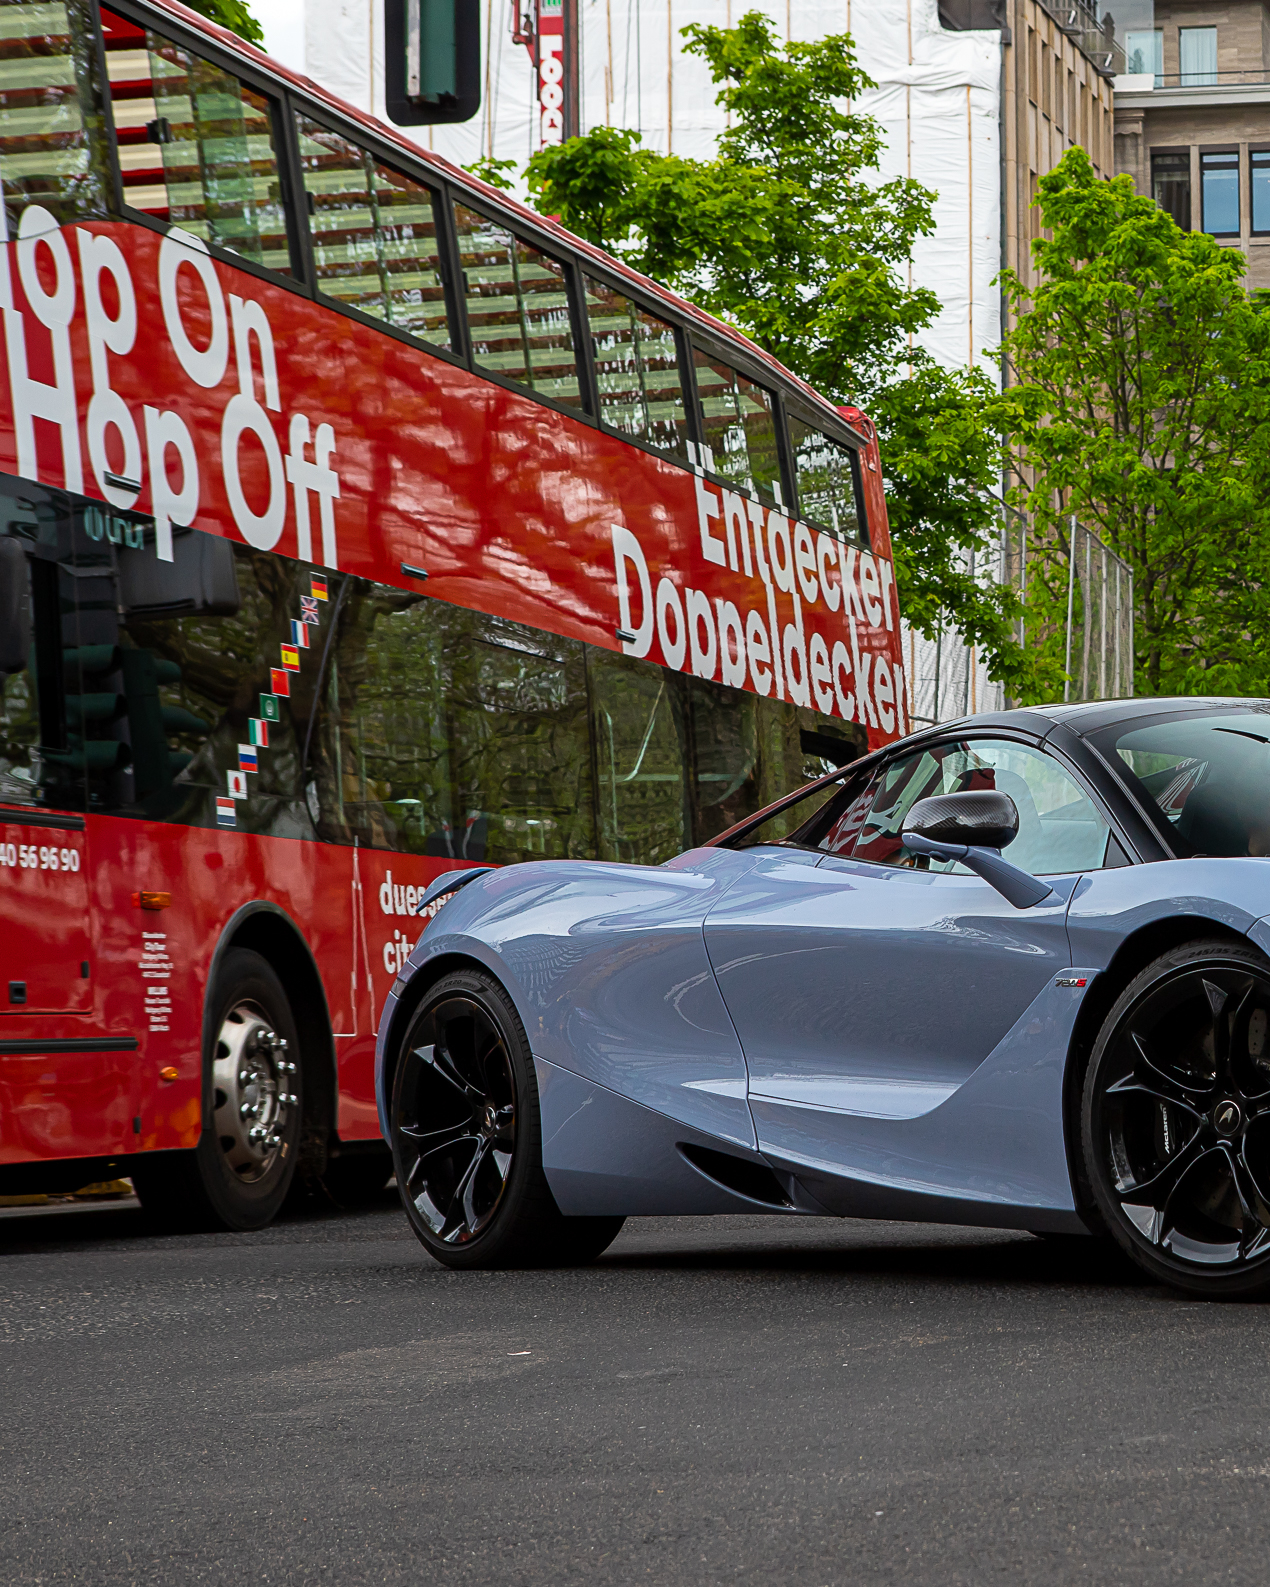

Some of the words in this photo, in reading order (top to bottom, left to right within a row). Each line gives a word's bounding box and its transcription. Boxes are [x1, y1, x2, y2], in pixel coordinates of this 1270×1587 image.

[158, 226, 281, 413] On
[4, 305, 199, 563] Hop
[221, 393, 339, 570] Off
[611, 523, 906, 736] Doppeldecker
[686, 439, 894, 632] Entdecker
[19, 844, 39, 869] 56
[40, 846, 60, 871] 96
[60, 848, 80, 872] 90
[1162, 1107, 1170, 1154] McLaren
